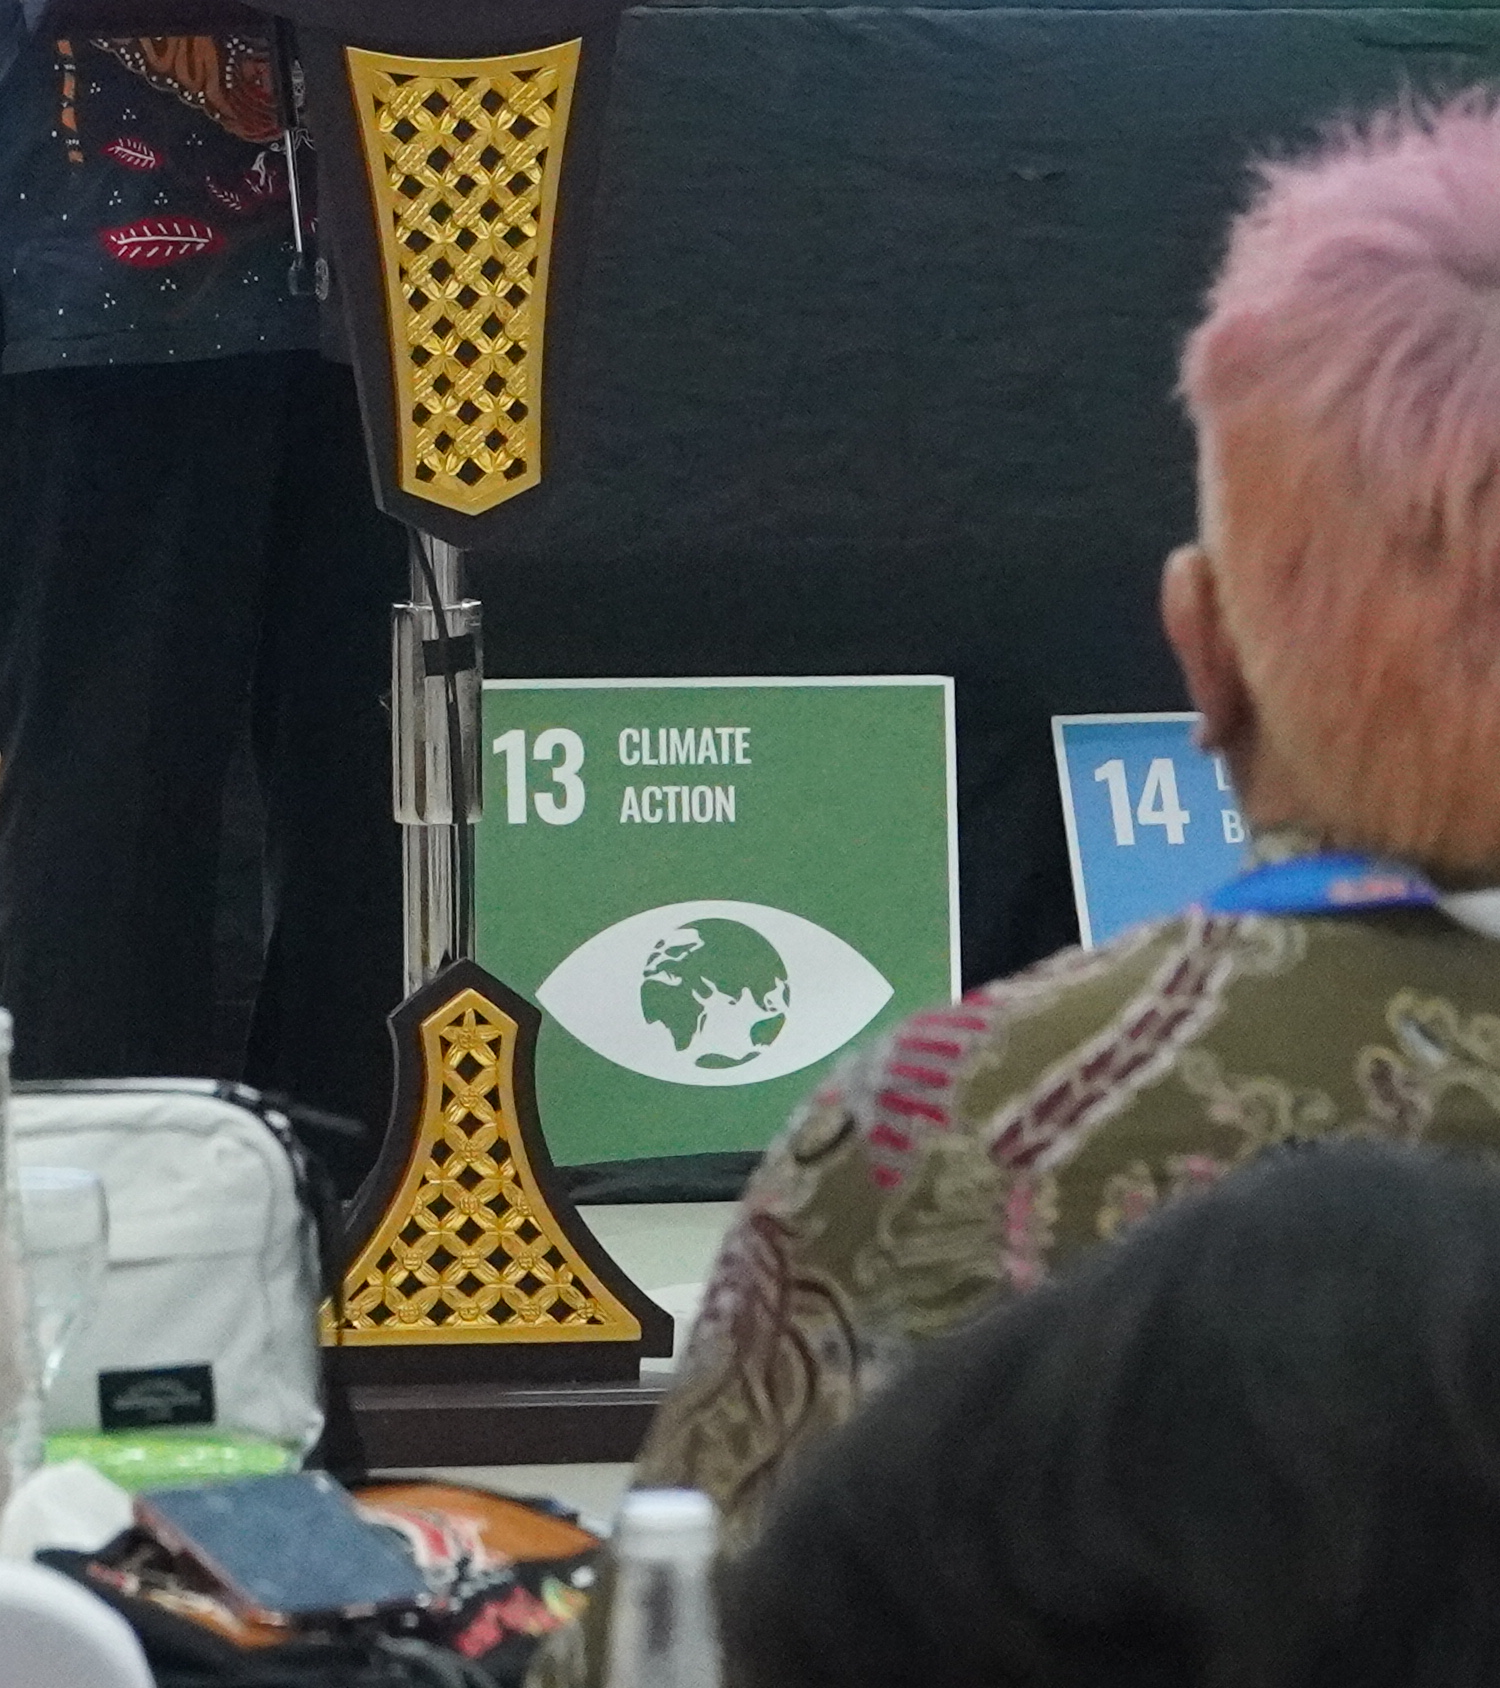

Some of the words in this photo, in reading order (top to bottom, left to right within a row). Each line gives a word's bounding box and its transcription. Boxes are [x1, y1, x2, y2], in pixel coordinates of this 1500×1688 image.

[493, 727, 586, 825] 13
[618, 727, 752, 766] CLIMATE
[620, 785, 736, 824] ACTION
[1094, 758, 1190, 846] 14
